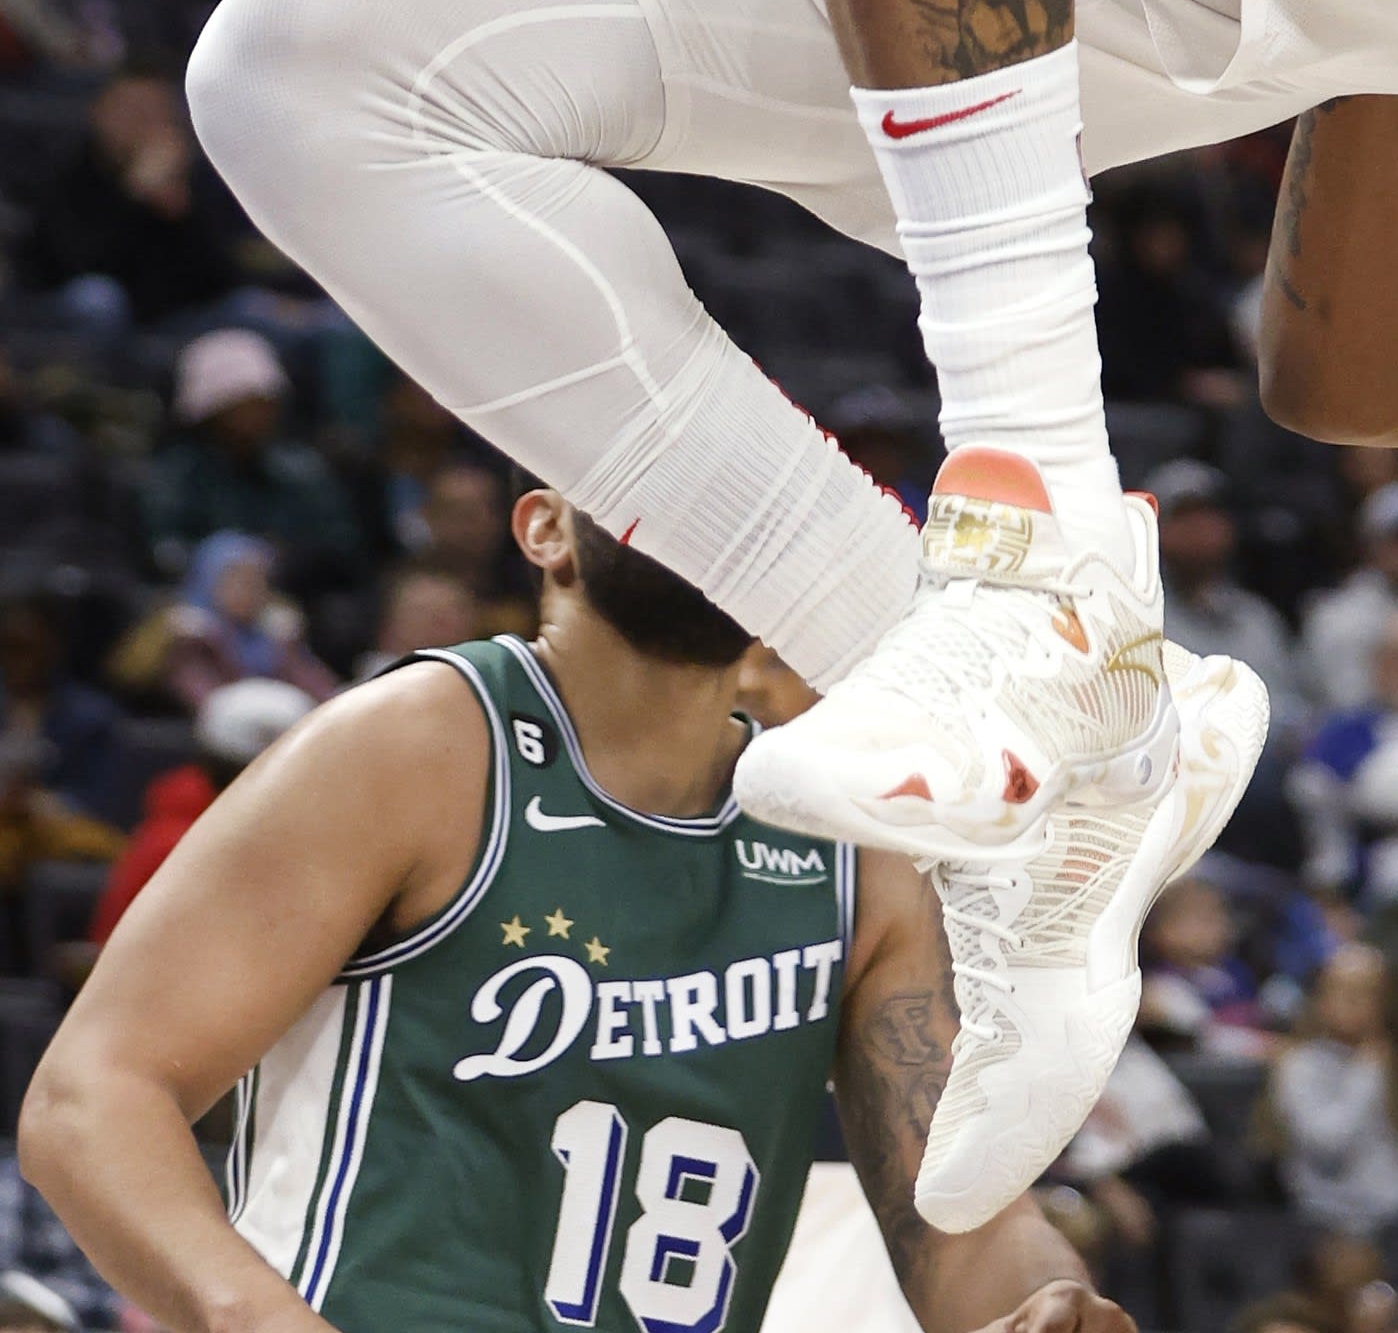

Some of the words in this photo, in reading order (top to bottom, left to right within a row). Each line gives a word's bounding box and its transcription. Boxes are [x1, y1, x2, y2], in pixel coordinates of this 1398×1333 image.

[512, 718, 546, 765] 6
[734, 839, 826, 875] UWM
[543, 1099, 761, 1333] 18
